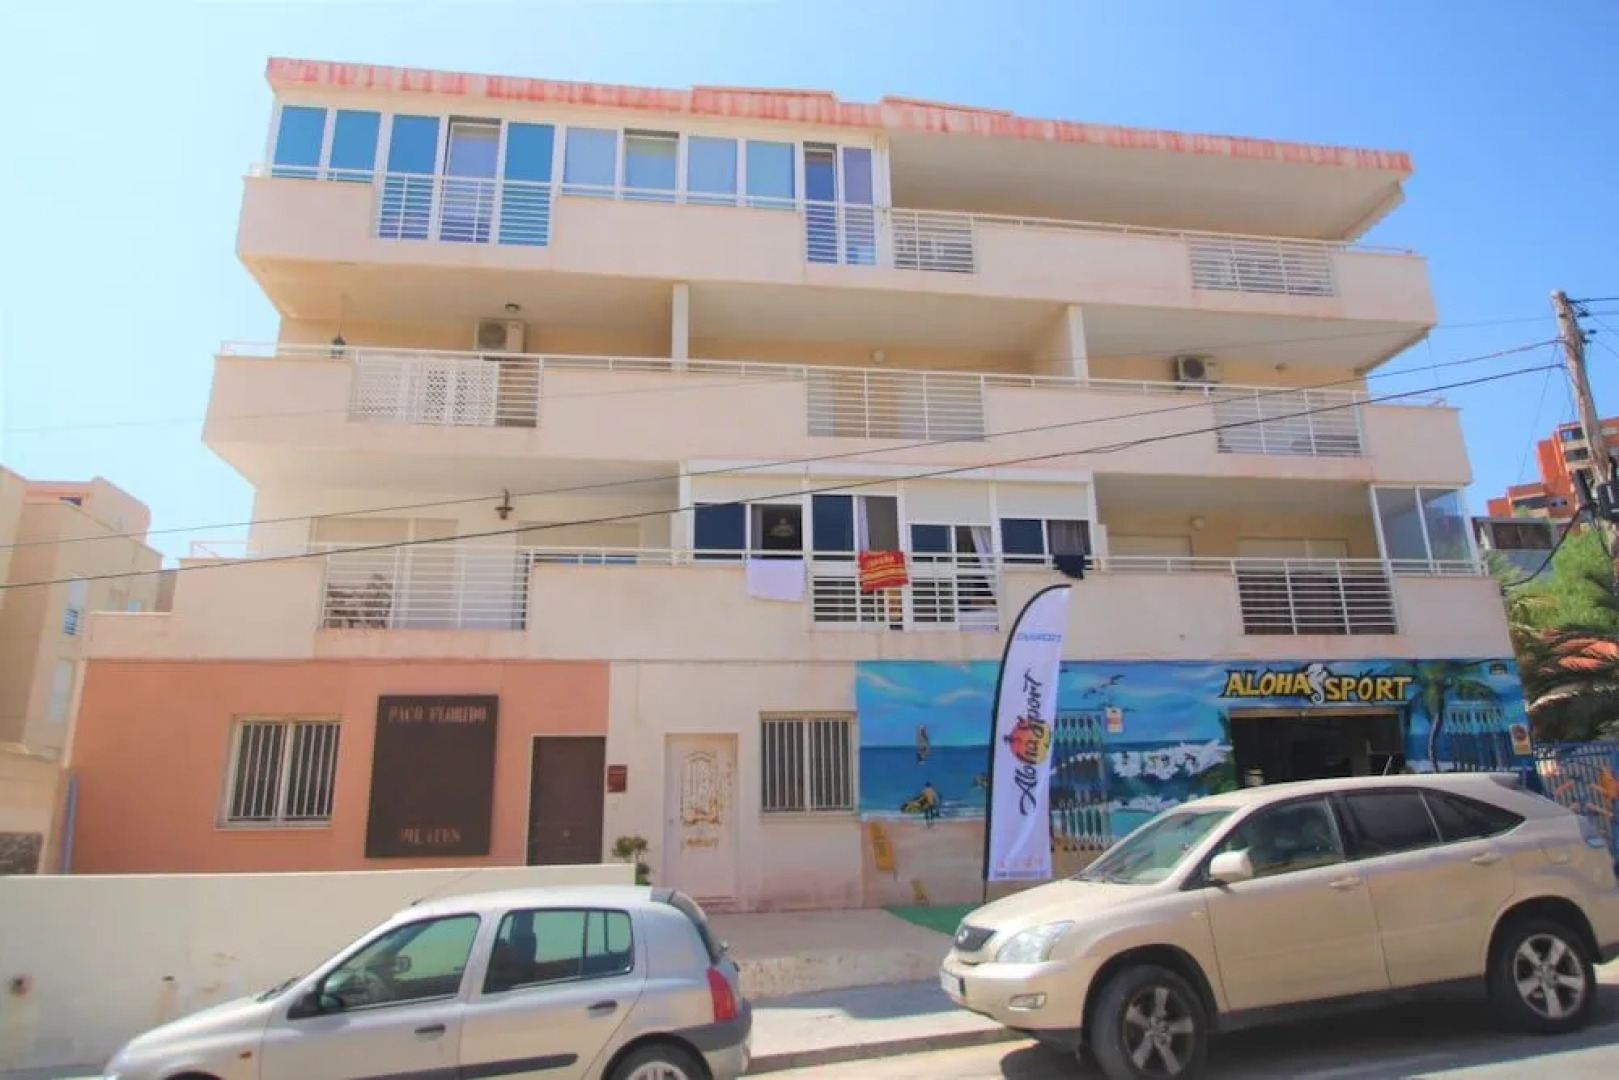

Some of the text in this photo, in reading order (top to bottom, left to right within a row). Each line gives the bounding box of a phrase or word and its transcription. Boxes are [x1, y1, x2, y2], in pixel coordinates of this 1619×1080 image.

[1224, 671, 1412, 701] ALOHA SPORT
[1014, 740, 1038, 816] Aloha
